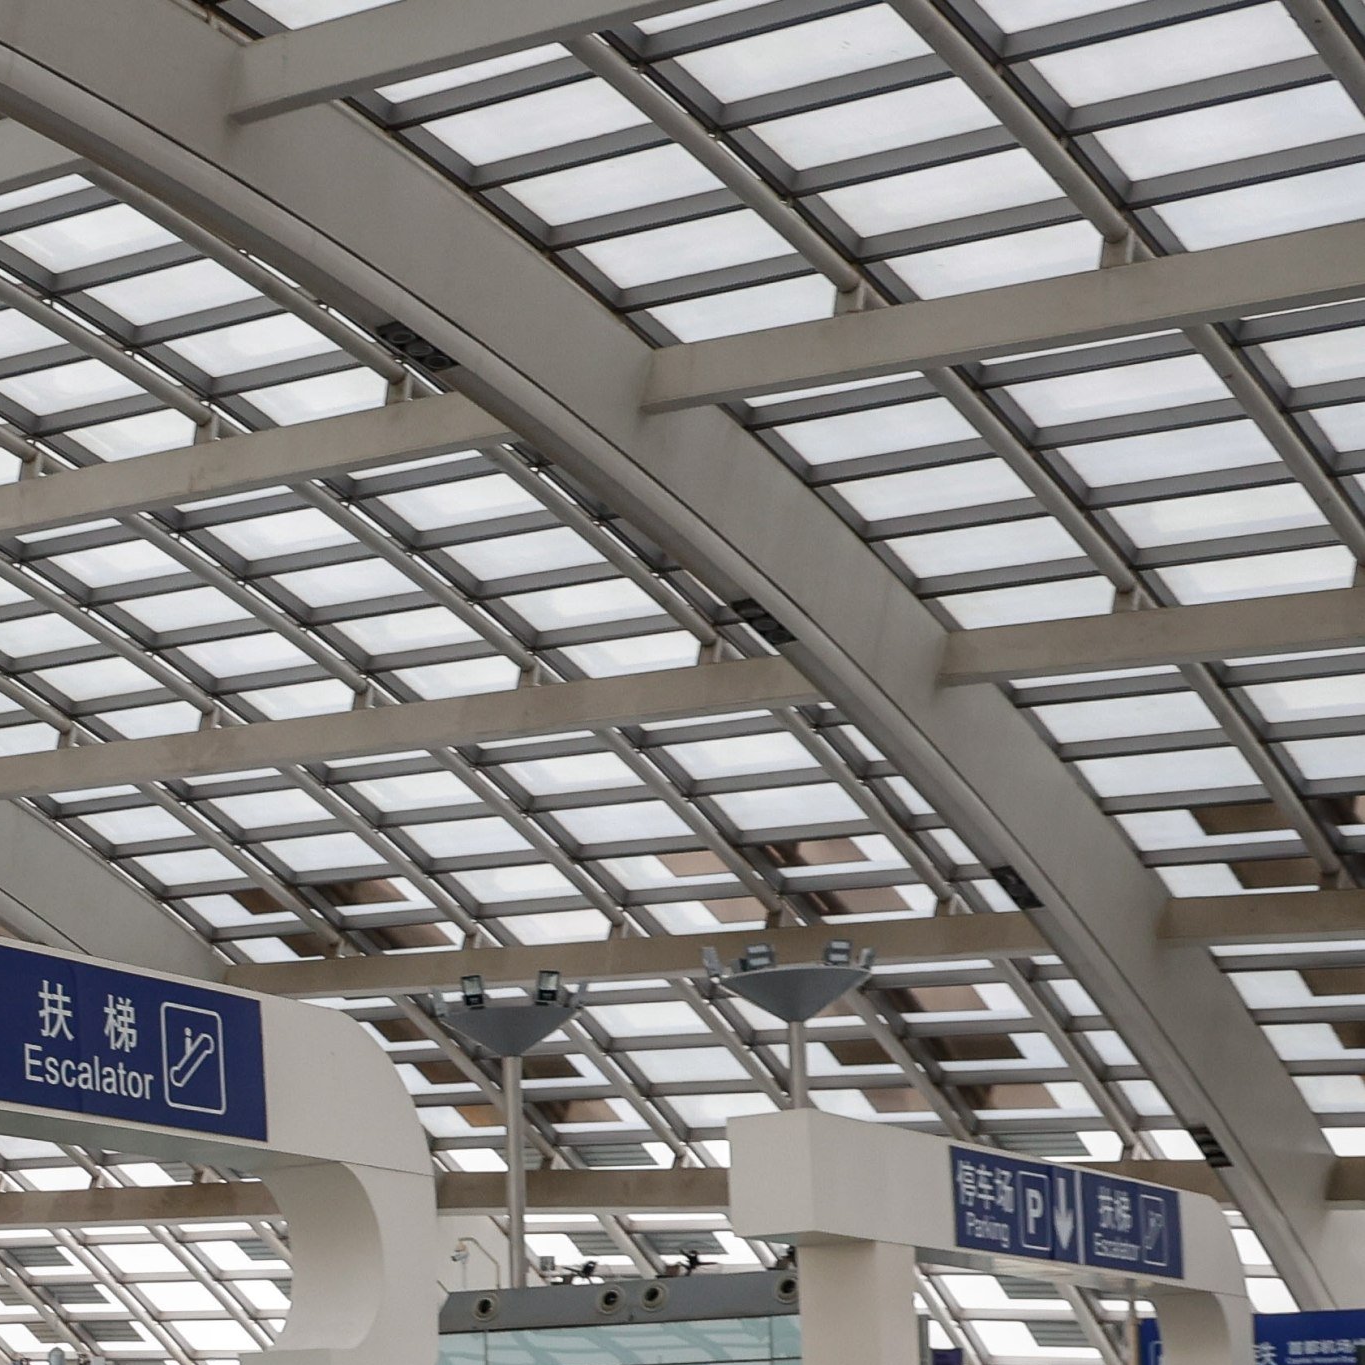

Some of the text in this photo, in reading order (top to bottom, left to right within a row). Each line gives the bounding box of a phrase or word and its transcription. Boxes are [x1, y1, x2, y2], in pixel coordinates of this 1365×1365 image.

[38, 979, 138, 1053] 扶梯
[23, 1043, 154, 1101] Escalator
[956, 1159, 1015, 1214] 停车场
[965, 1211, 1011, 1249] Parking
